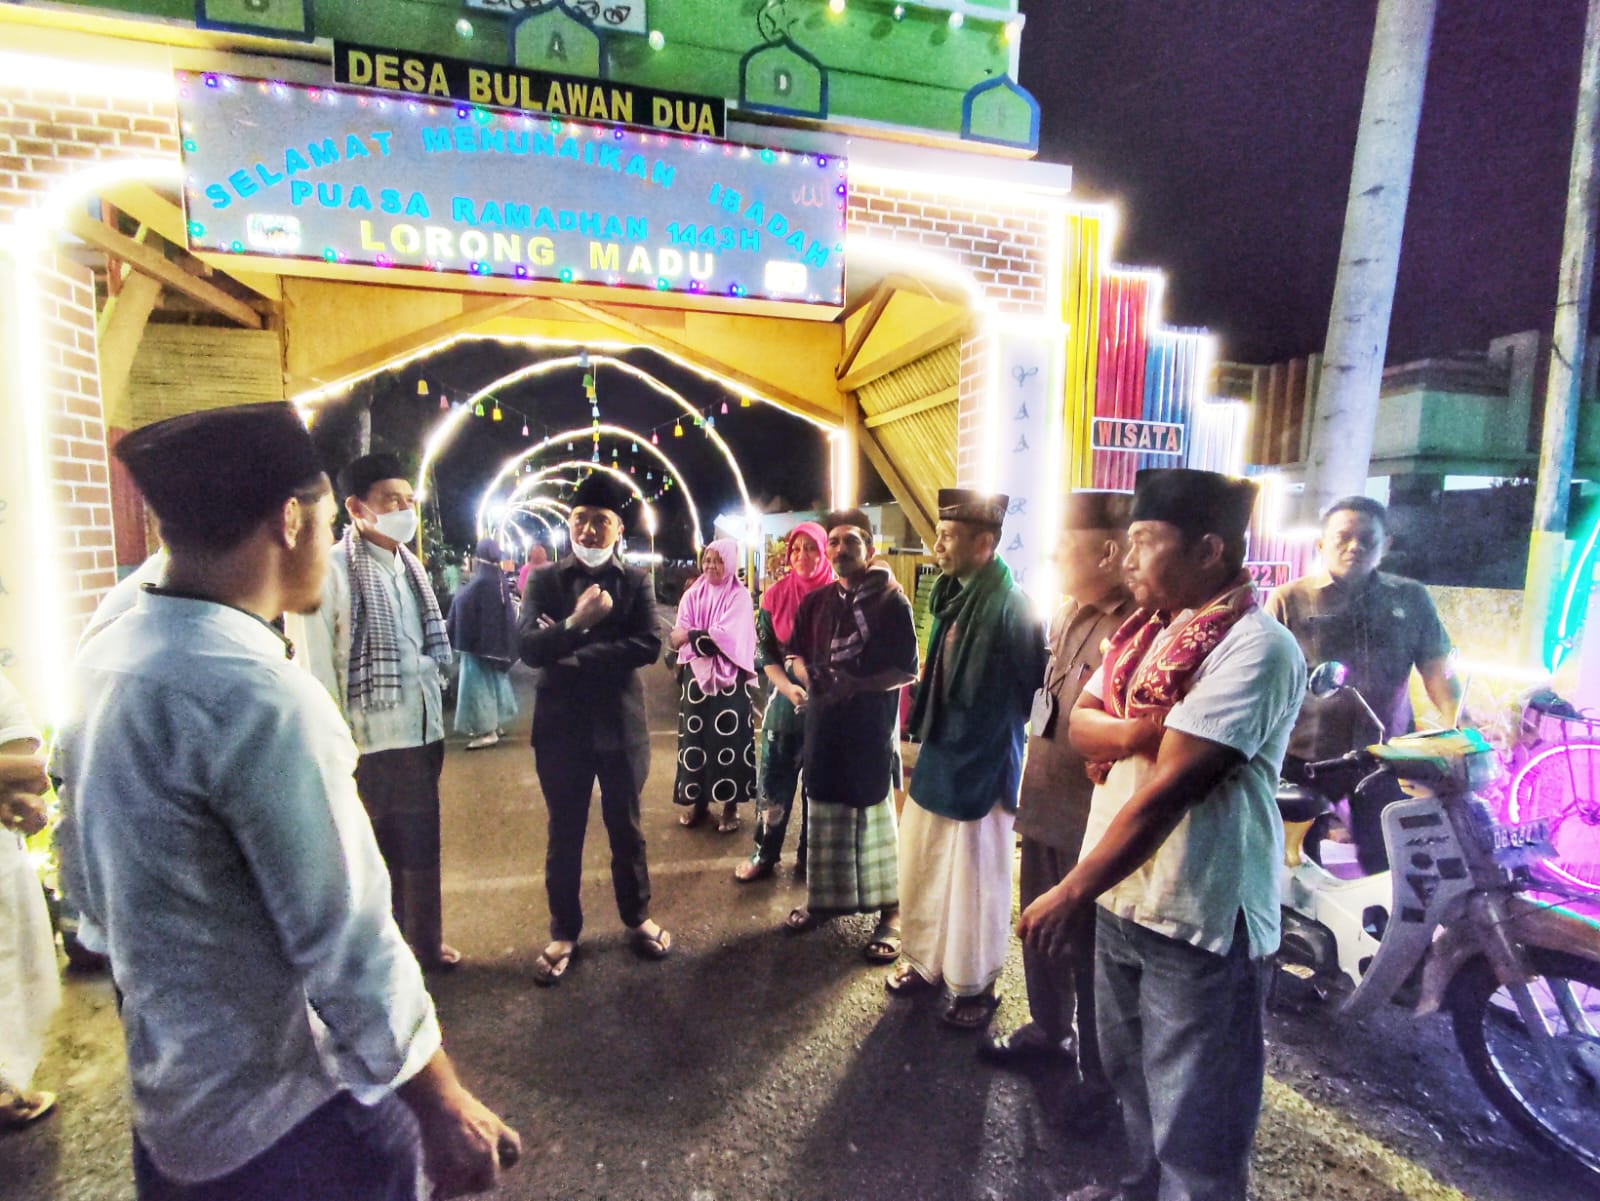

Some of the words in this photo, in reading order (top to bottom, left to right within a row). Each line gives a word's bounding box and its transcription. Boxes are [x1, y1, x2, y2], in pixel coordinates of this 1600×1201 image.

[347, 50, 450, 97] DESA
[468, 68, 633, 123] BULAWAN
[652, 96, 716, 136] DUA
[204, 131, 392, 209] SELAMAT
[422, 126, 676, 188] MENUNAIKAN
[708, 182, 830, 268] IBADAH
[290, 180, 430, 218] PUASA
[452, 196, 648, 241] RAMADHAN
[666, 222, 760, 251] 1443H
[359, 220, 555, 265] LORONG
[589, 241, 714, 280] MADU
[1098, 421, 1178, 451] WISATA
